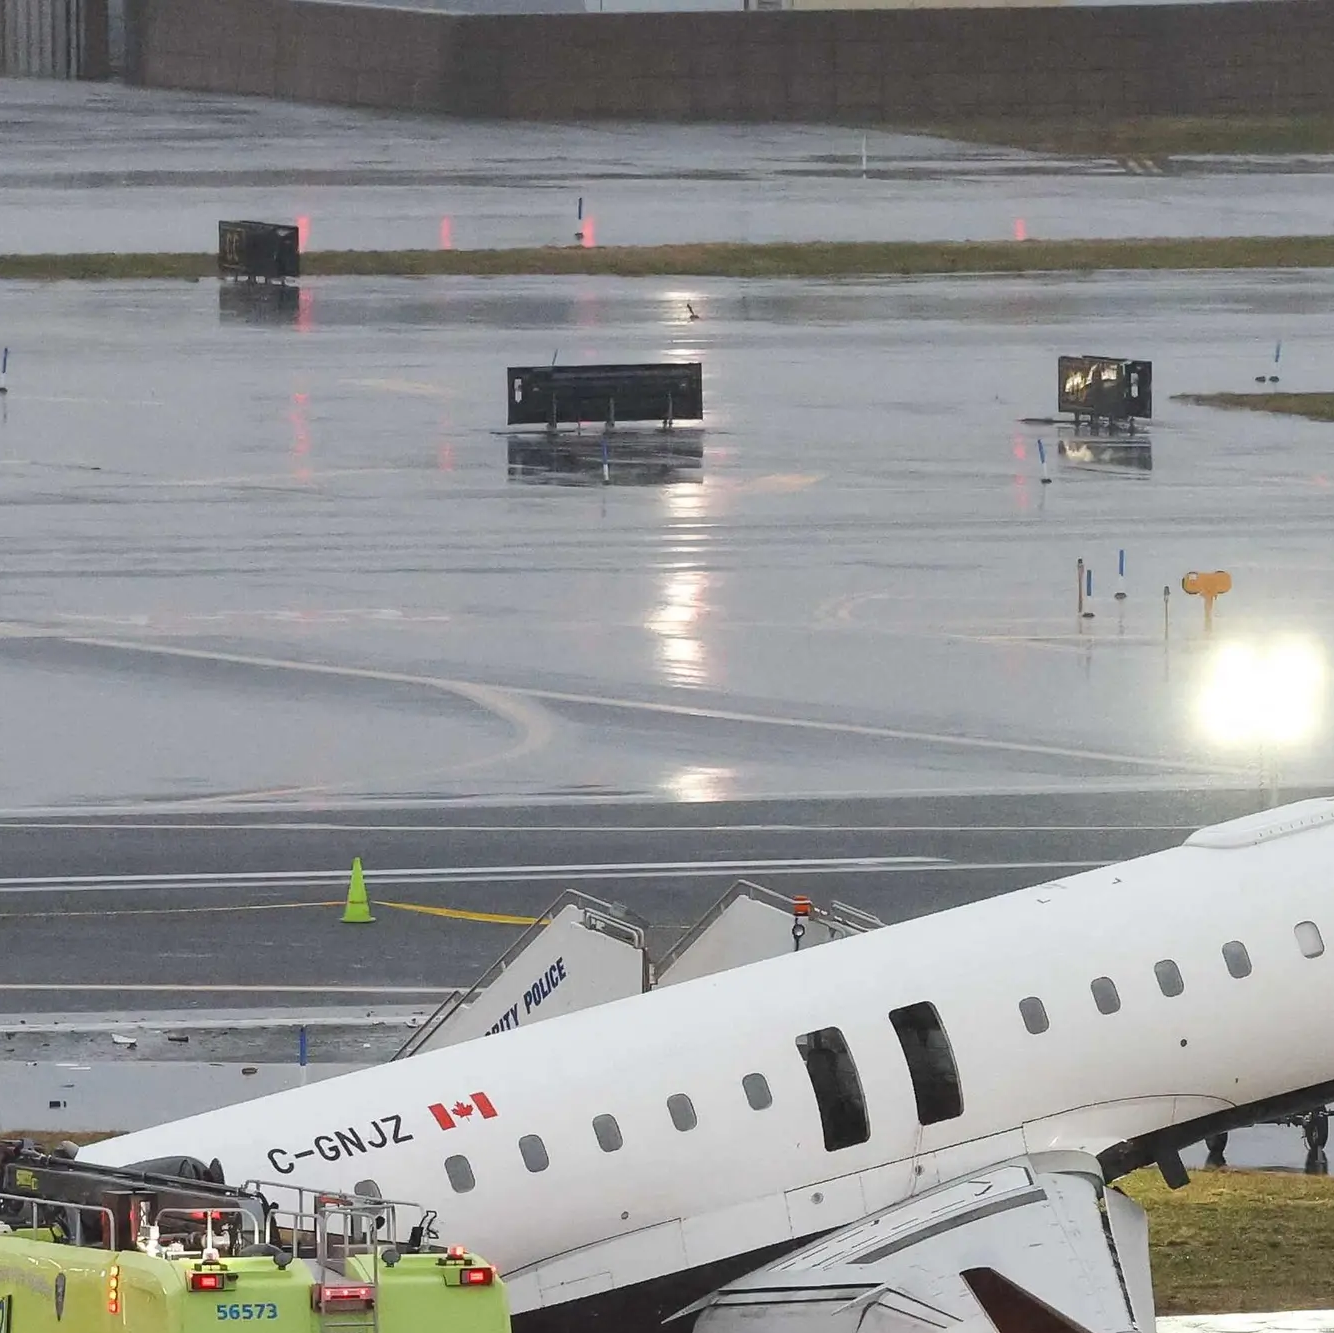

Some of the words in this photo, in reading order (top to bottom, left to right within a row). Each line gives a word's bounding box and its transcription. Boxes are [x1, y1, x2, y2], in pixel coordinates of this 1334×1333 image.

[485, 1003, 519, 1036] RITY
[524, 956, 567, 1015] POLICE
[267, 1114, 414, 1175] C-GNJZ
[216, 1303, 278, 1320] 56573
